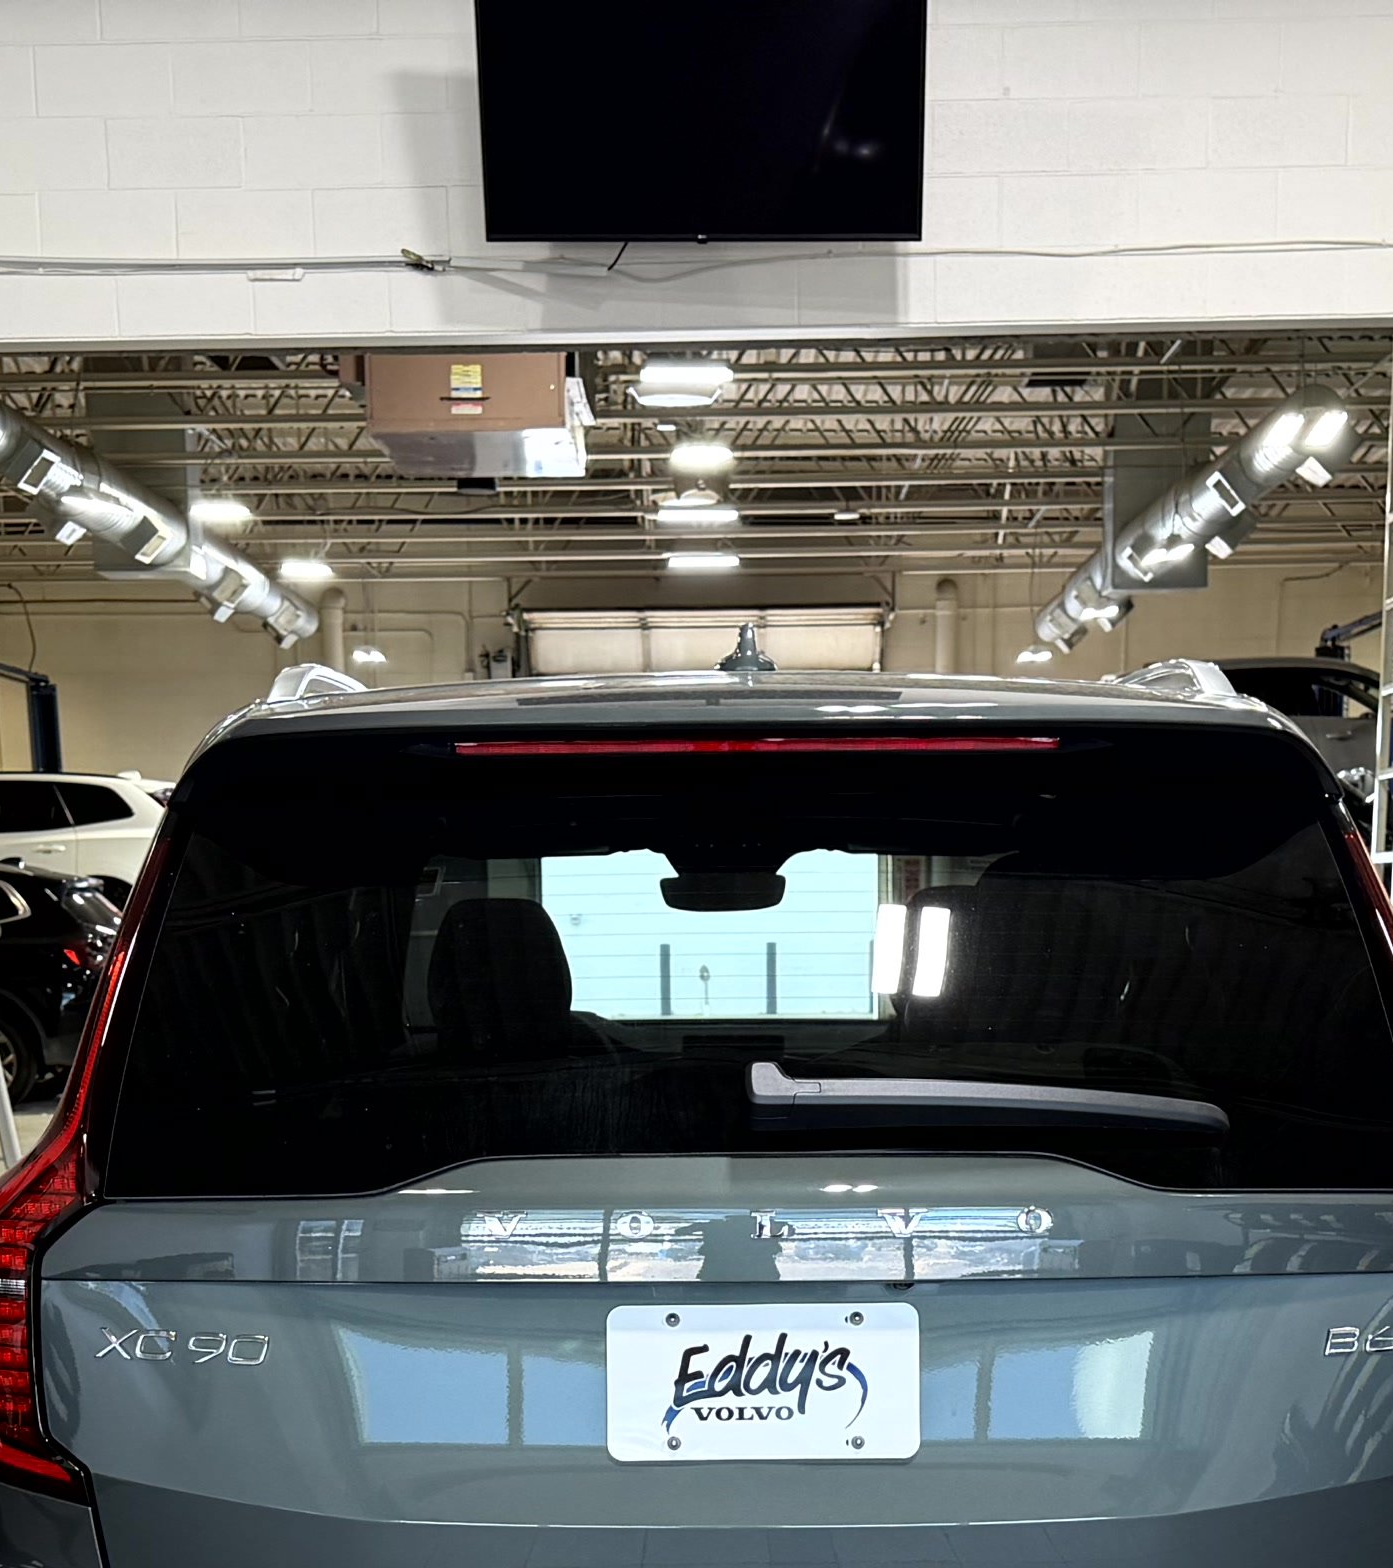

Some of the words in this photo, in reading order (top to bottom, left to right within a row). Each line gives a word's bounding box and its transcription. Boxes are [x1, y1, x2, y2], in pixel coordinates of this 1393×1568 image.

[475, 1206, 1056, 1240] VOLVO
[673, 1332, 851, 1415] Eddy's
[690, 1406, 794, 1421] VOLVO
